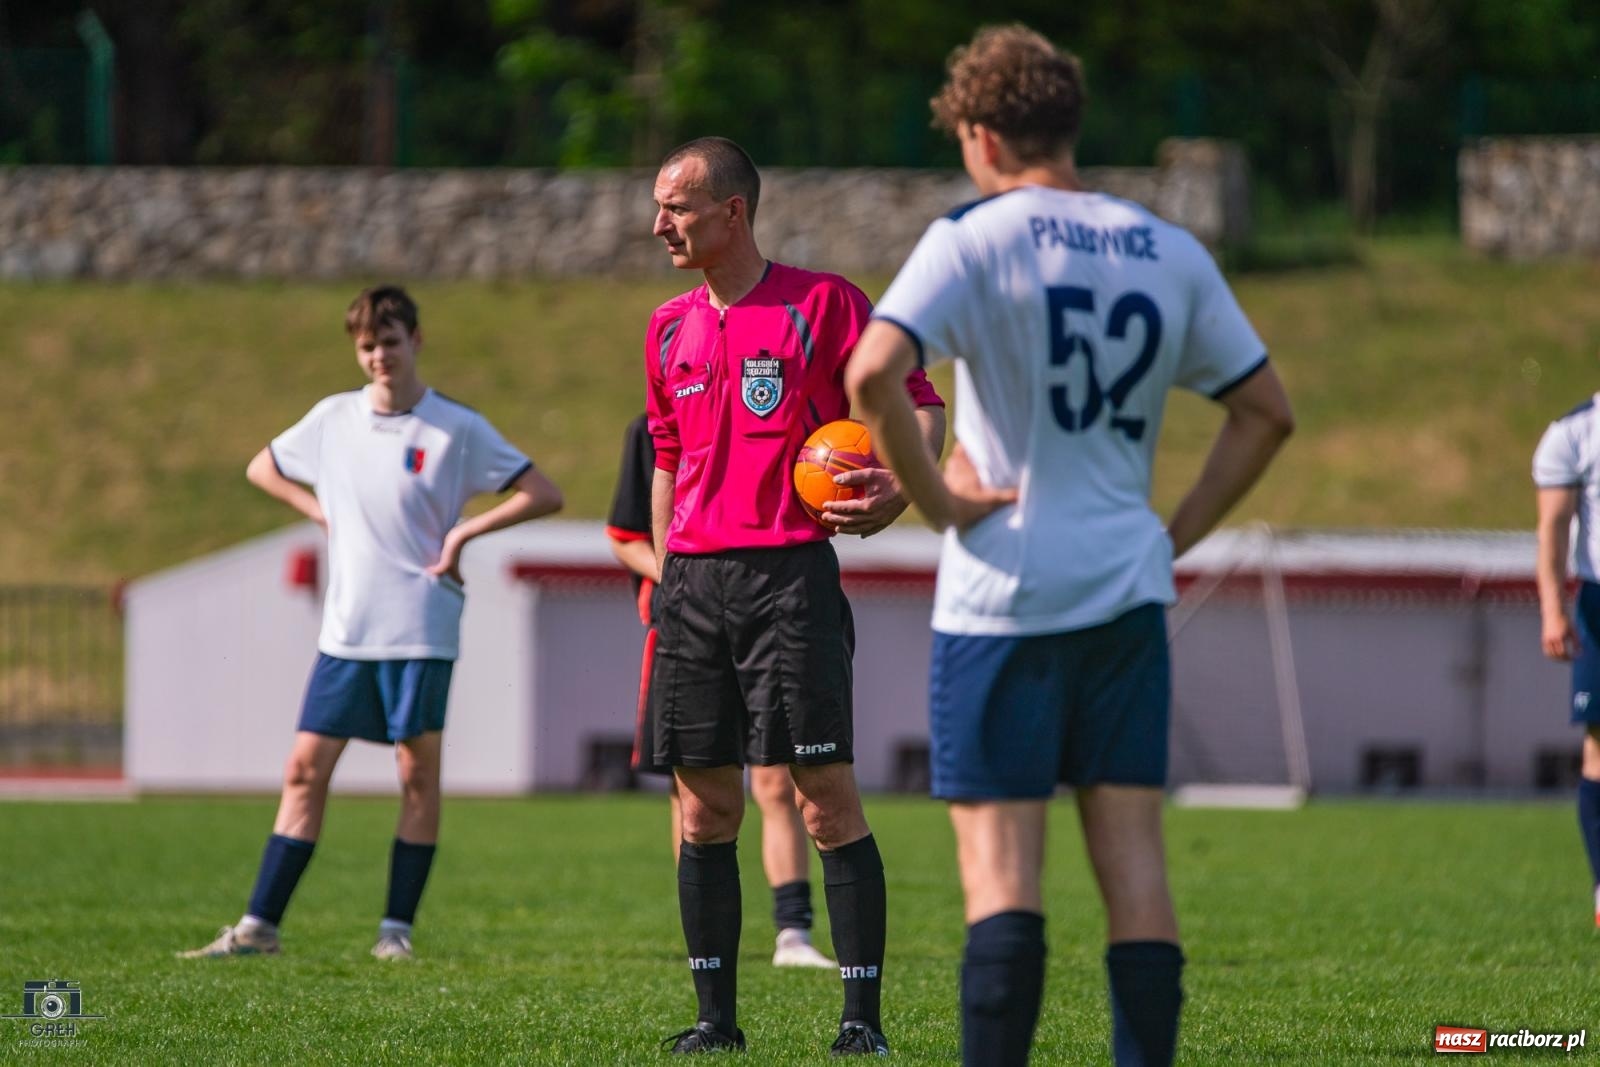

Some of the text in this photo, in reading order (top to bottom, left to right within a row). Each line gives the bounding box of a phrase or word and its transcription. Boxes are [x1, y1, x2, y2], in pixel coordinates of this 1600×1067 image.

[1045, 285, 1163, 441] 52
[675, 383, 705, 398] zina
[794, 742, 837, 755] zina
[688, 956, 721, 970] ina
